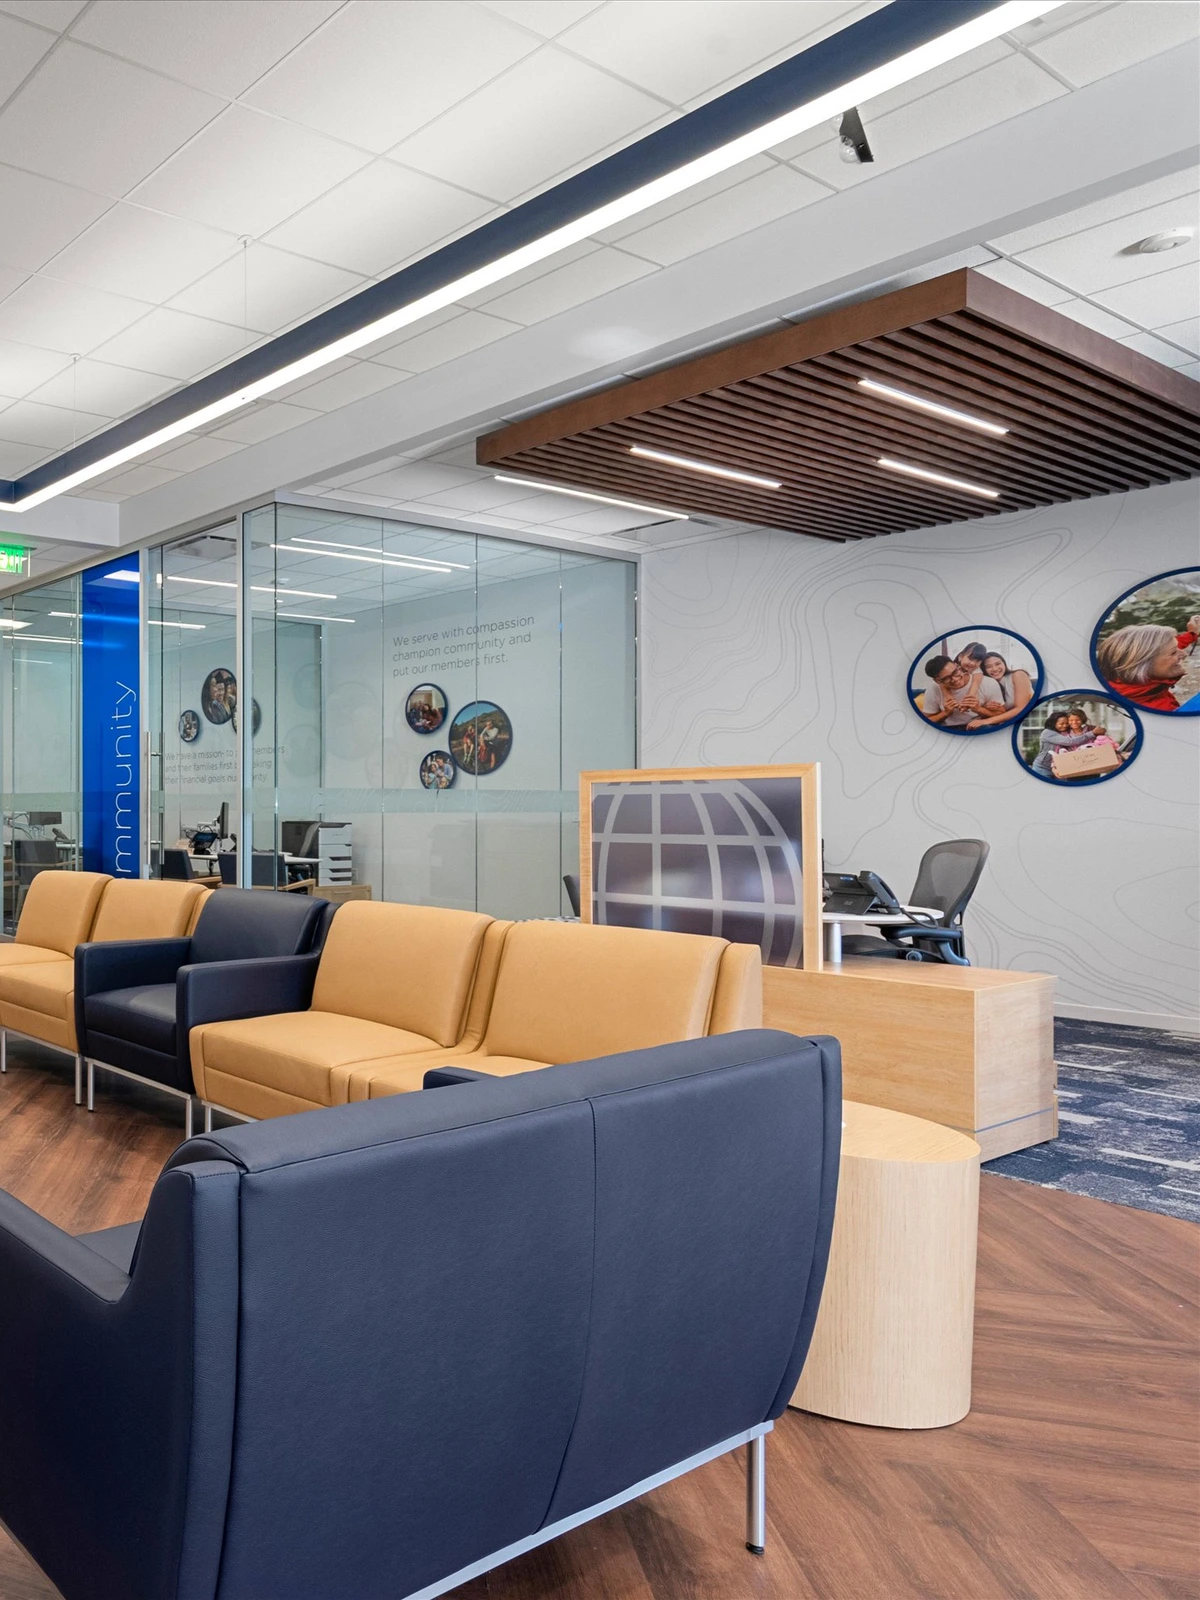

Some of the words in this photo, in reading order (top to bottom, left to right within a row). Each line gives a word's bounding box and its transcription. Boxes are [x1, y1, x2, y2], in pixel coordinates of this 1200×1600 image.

[392, 635, 410, 648] We
[412, 631, 439, 644] serve
[441, 626, 465, 640] with
[466, 615, 536, 636] compassion
[392, 646, 441, 664] champion
[443, 635, 506, 656] community
[508, 631, 532, 646] and
[392, 666, 410, 679] put
[411, 664, 429, 675] our
[431, 657, 481, 673] members
[483, 652, 509, 666] first.
[111, 680, 137, 878] mmunity
